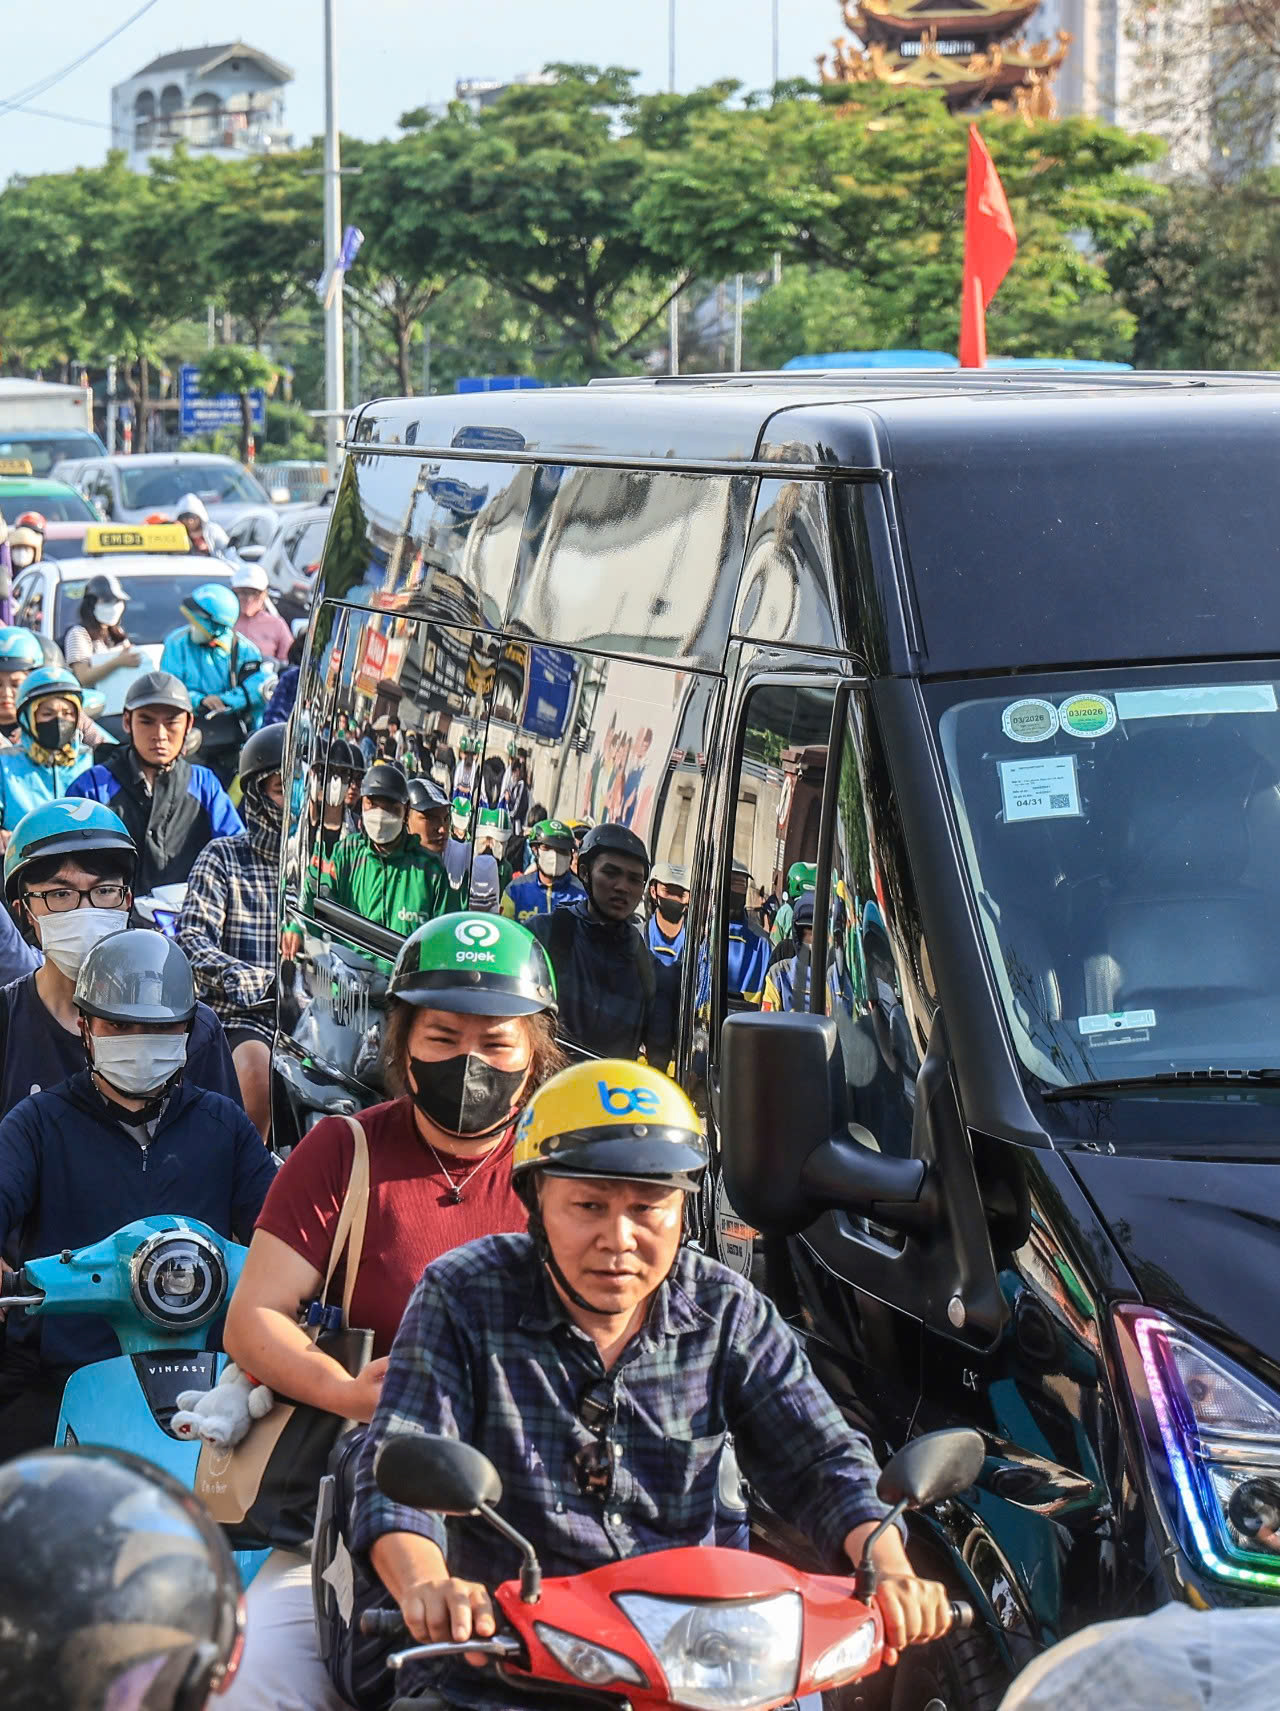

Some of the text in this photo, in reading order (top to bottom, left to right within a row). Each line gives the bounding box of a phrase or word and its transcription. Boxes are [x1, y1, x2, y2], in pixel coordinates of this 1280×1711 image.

[1068, 708, 1103, 717] 03/2026
[1013, 715, 1044, 724] 03/2026
[1016, 798, 1042, 807] 04/31
[456, 951, 496, 963] gojek
[597, 1080, 660, 1116] be
[149, 1365, 206, 1375] VINFAST
